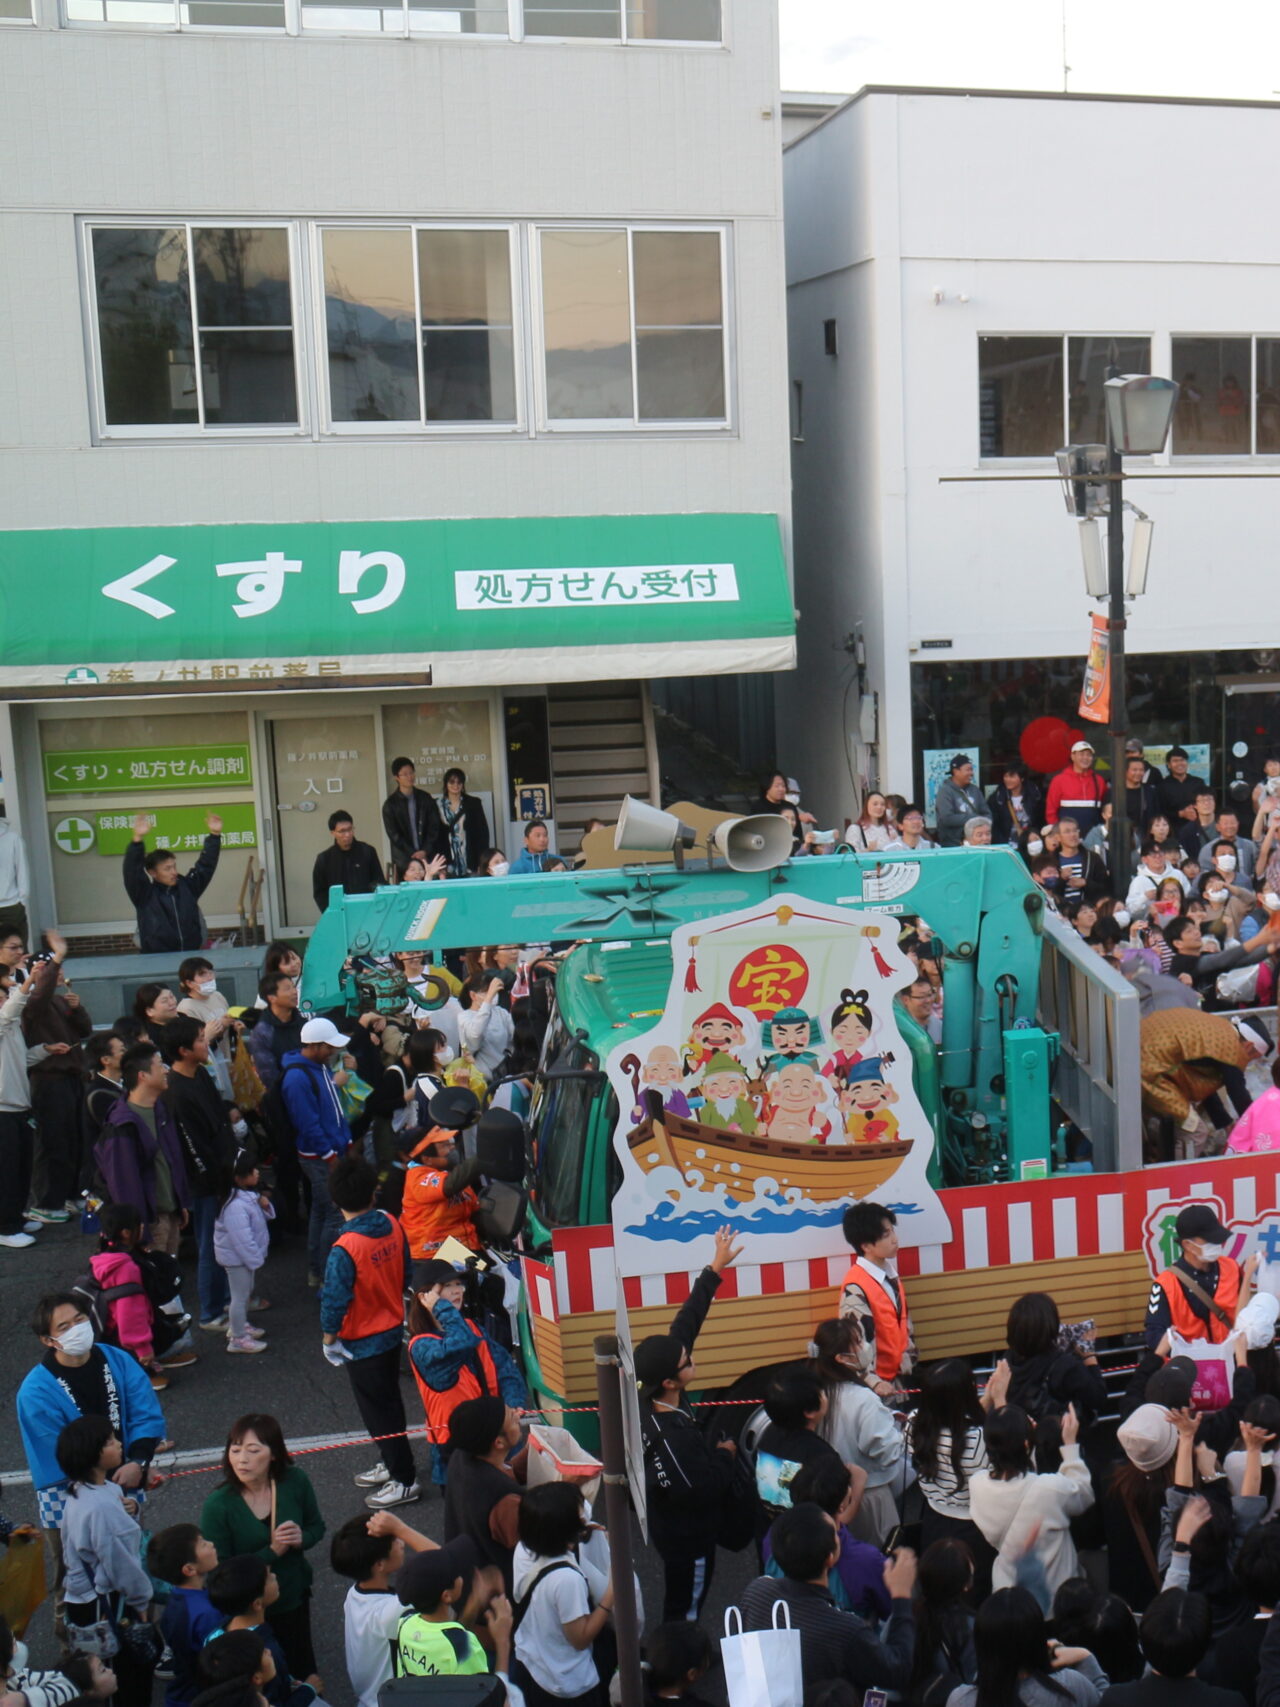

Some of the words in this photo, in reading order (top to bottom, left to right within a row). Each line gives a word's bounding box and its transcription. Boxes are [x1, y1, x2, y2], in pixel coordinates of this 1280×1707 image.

[101, 550, 407, 619] くすり
[474, 567, 718, 604] 処方せん受付
[53, 757, 245, 781] くすり・処方せん調剤
[303, 777, 343, 796] 入口
[736, 949, 806, 1013] 宝
